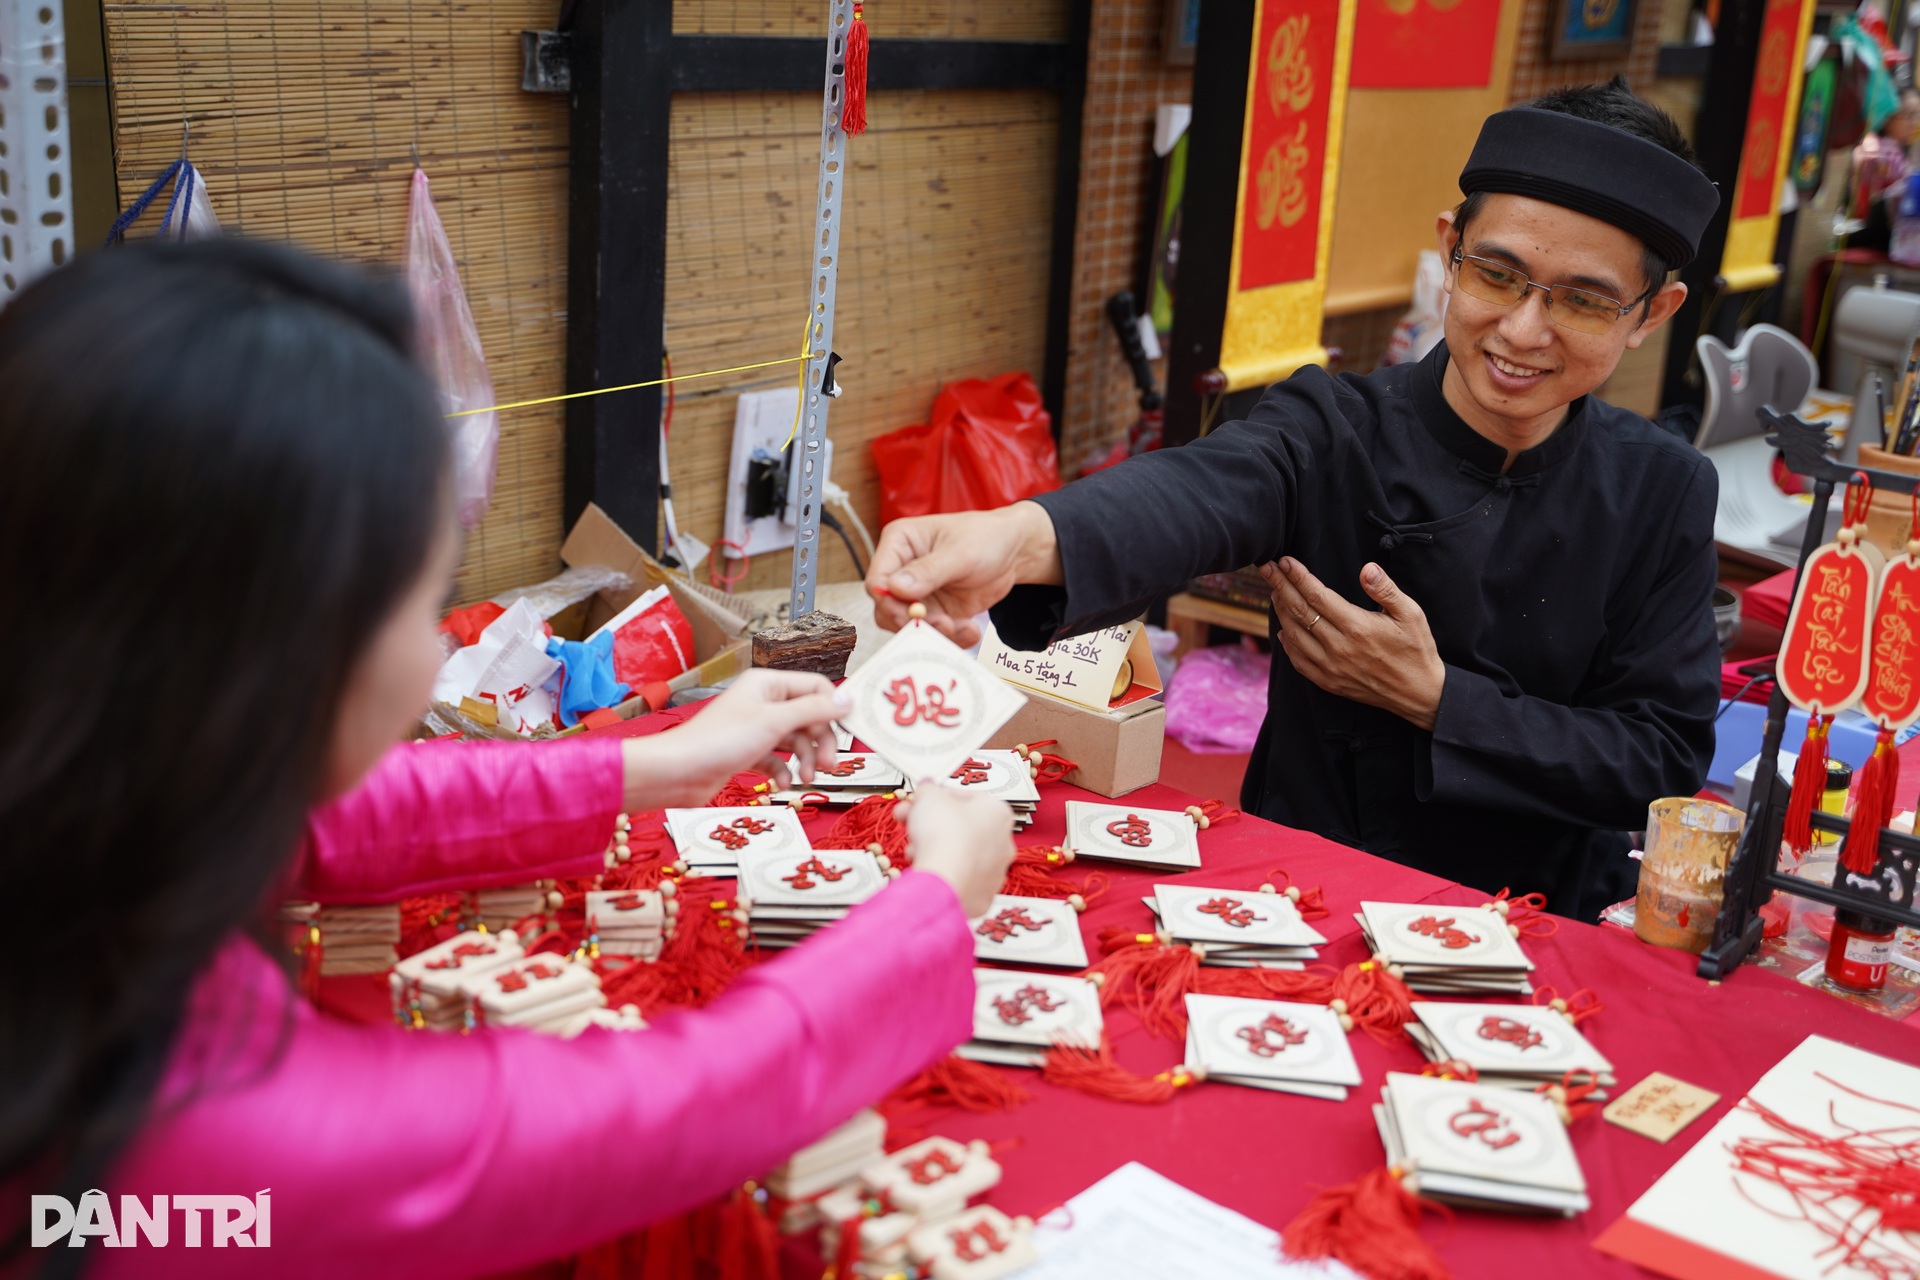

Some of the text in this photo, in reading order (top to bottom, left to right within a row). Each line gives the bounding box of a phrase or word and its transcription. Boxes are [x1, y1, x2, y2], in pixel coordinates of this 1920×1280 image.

[1072, 643, 1102, 662] 30K
[996, 652, 1020, 672] Mua
[1024, 660, 1033, 674] 5
[1062, 670, 1077, 687] 1
